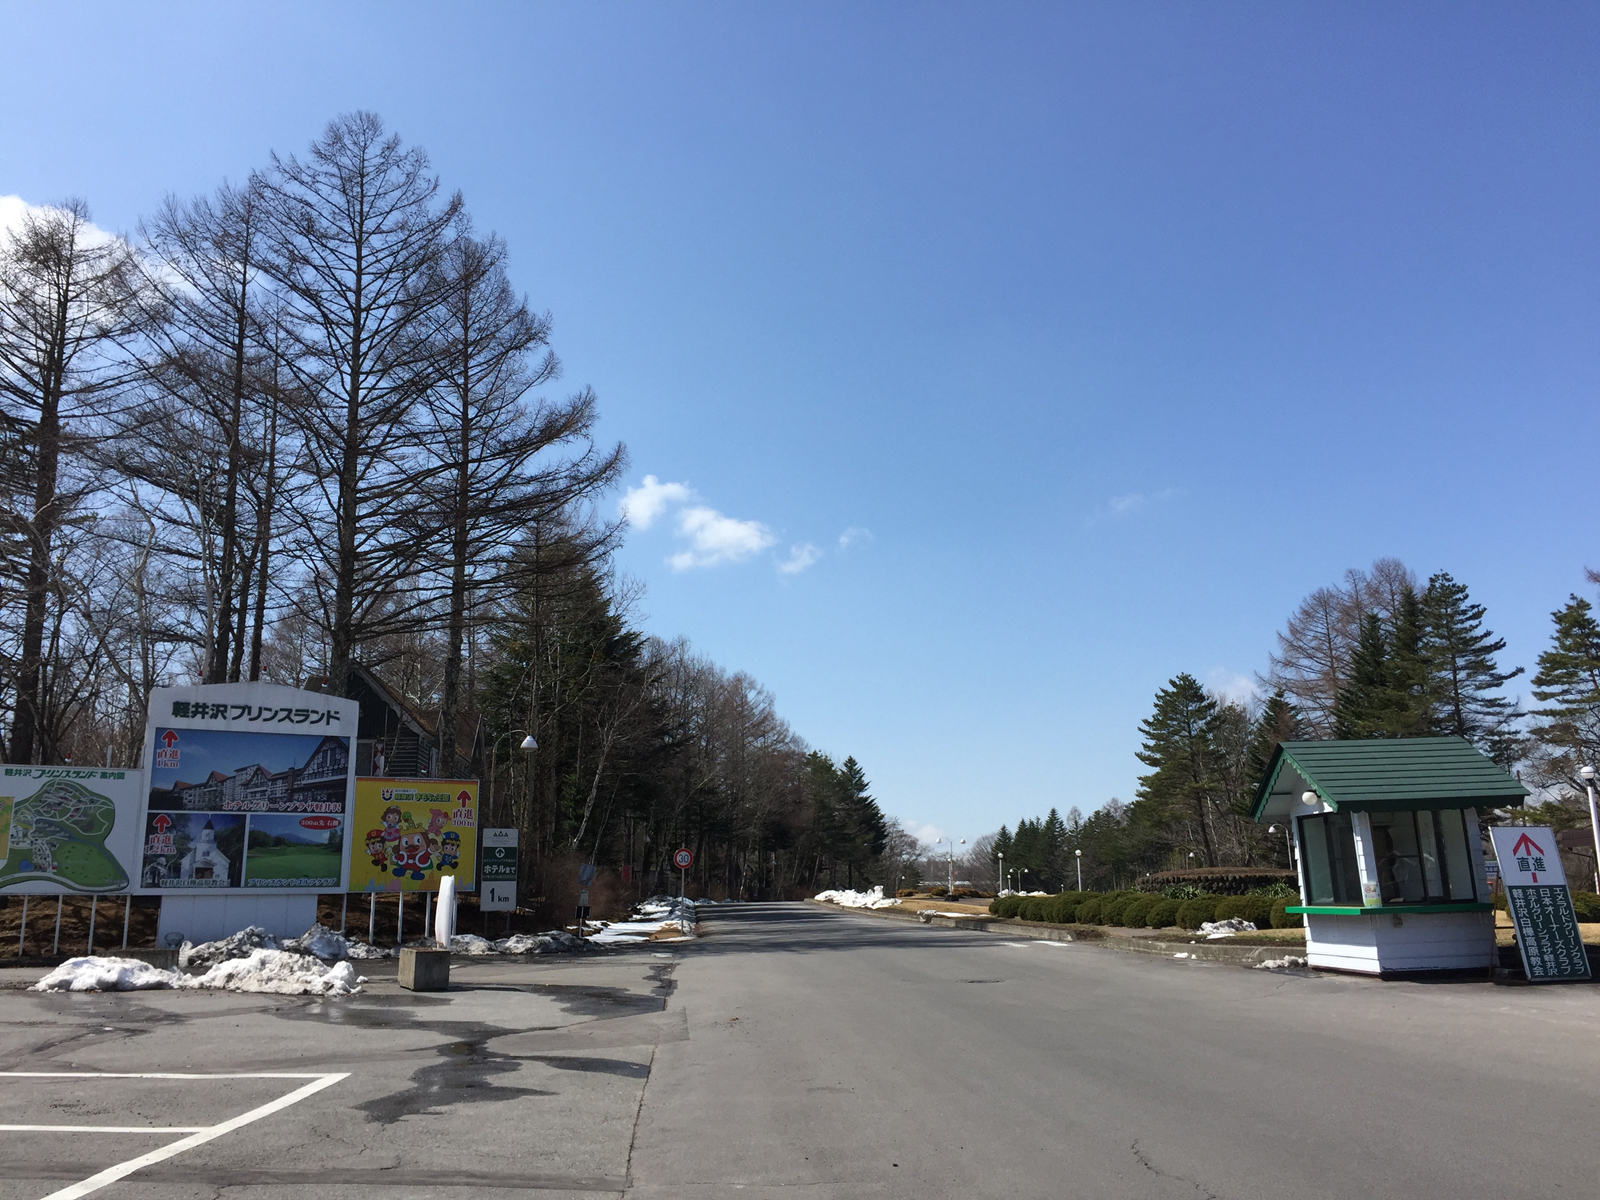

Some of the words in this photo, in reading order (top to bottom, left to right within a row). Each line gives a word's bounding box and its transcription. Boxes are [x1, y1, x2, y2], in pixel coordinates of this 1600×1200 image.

[171, 701, 341, 726] 軽井沢プリンスランド
[156, 749, 180, 760] 直進
[4, 768, 32, 776] 軽井沢
[32, 769, 99, 779] プリンスランド
[222, 800, 341, 813] ホテルグリーンプラザ軽井沢
[452, 808, 474, 820] 直進
[451, 819, 475, 827] 300m
[149, 833, 173, 845] 直進
[678, 853, 689, 863] 30
[484, 864, 516, 874] ホテルまで
[1516, 857, 1547, 873] 直進
[489, 887, 495, 902] 1
[1512, 888, 1545, 976] 軽井沢白樺高原教会
[1525, 888, 1559, 976] ホテルグリーンプラザ軽井沢
[1539, 888, 1571, 975] 日本オーナーズクラブ
[1553, 887, 1585, 974] エメラルドグリーンクラブ
